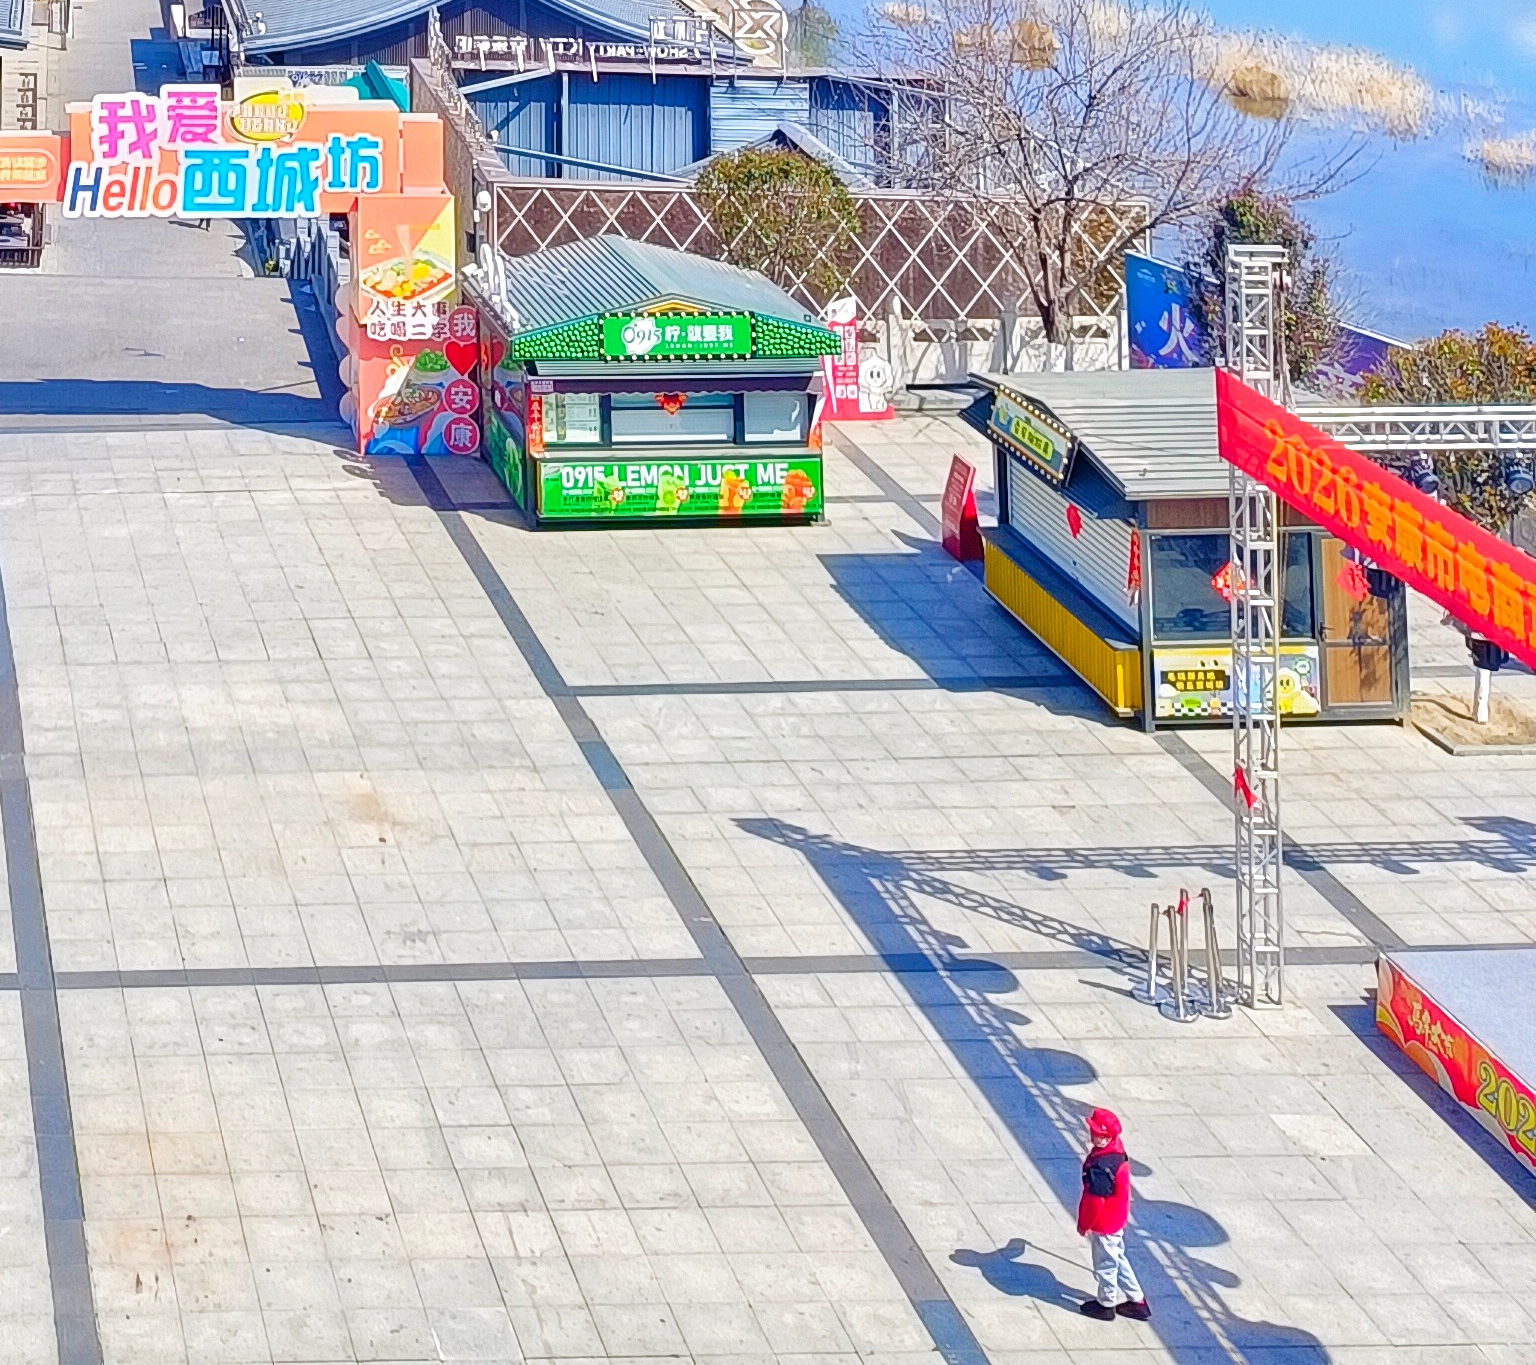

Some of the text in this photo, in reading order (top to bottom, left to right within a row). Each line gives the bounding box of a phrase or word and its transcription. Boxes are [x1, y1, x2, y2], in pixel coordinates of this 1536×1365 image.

[99, 91, 218, 159] 我爱
[68, 167, 178, 212] Hello
[182, 137, 380, 212] 西城坊
[756, 463, 789, 485] ME
